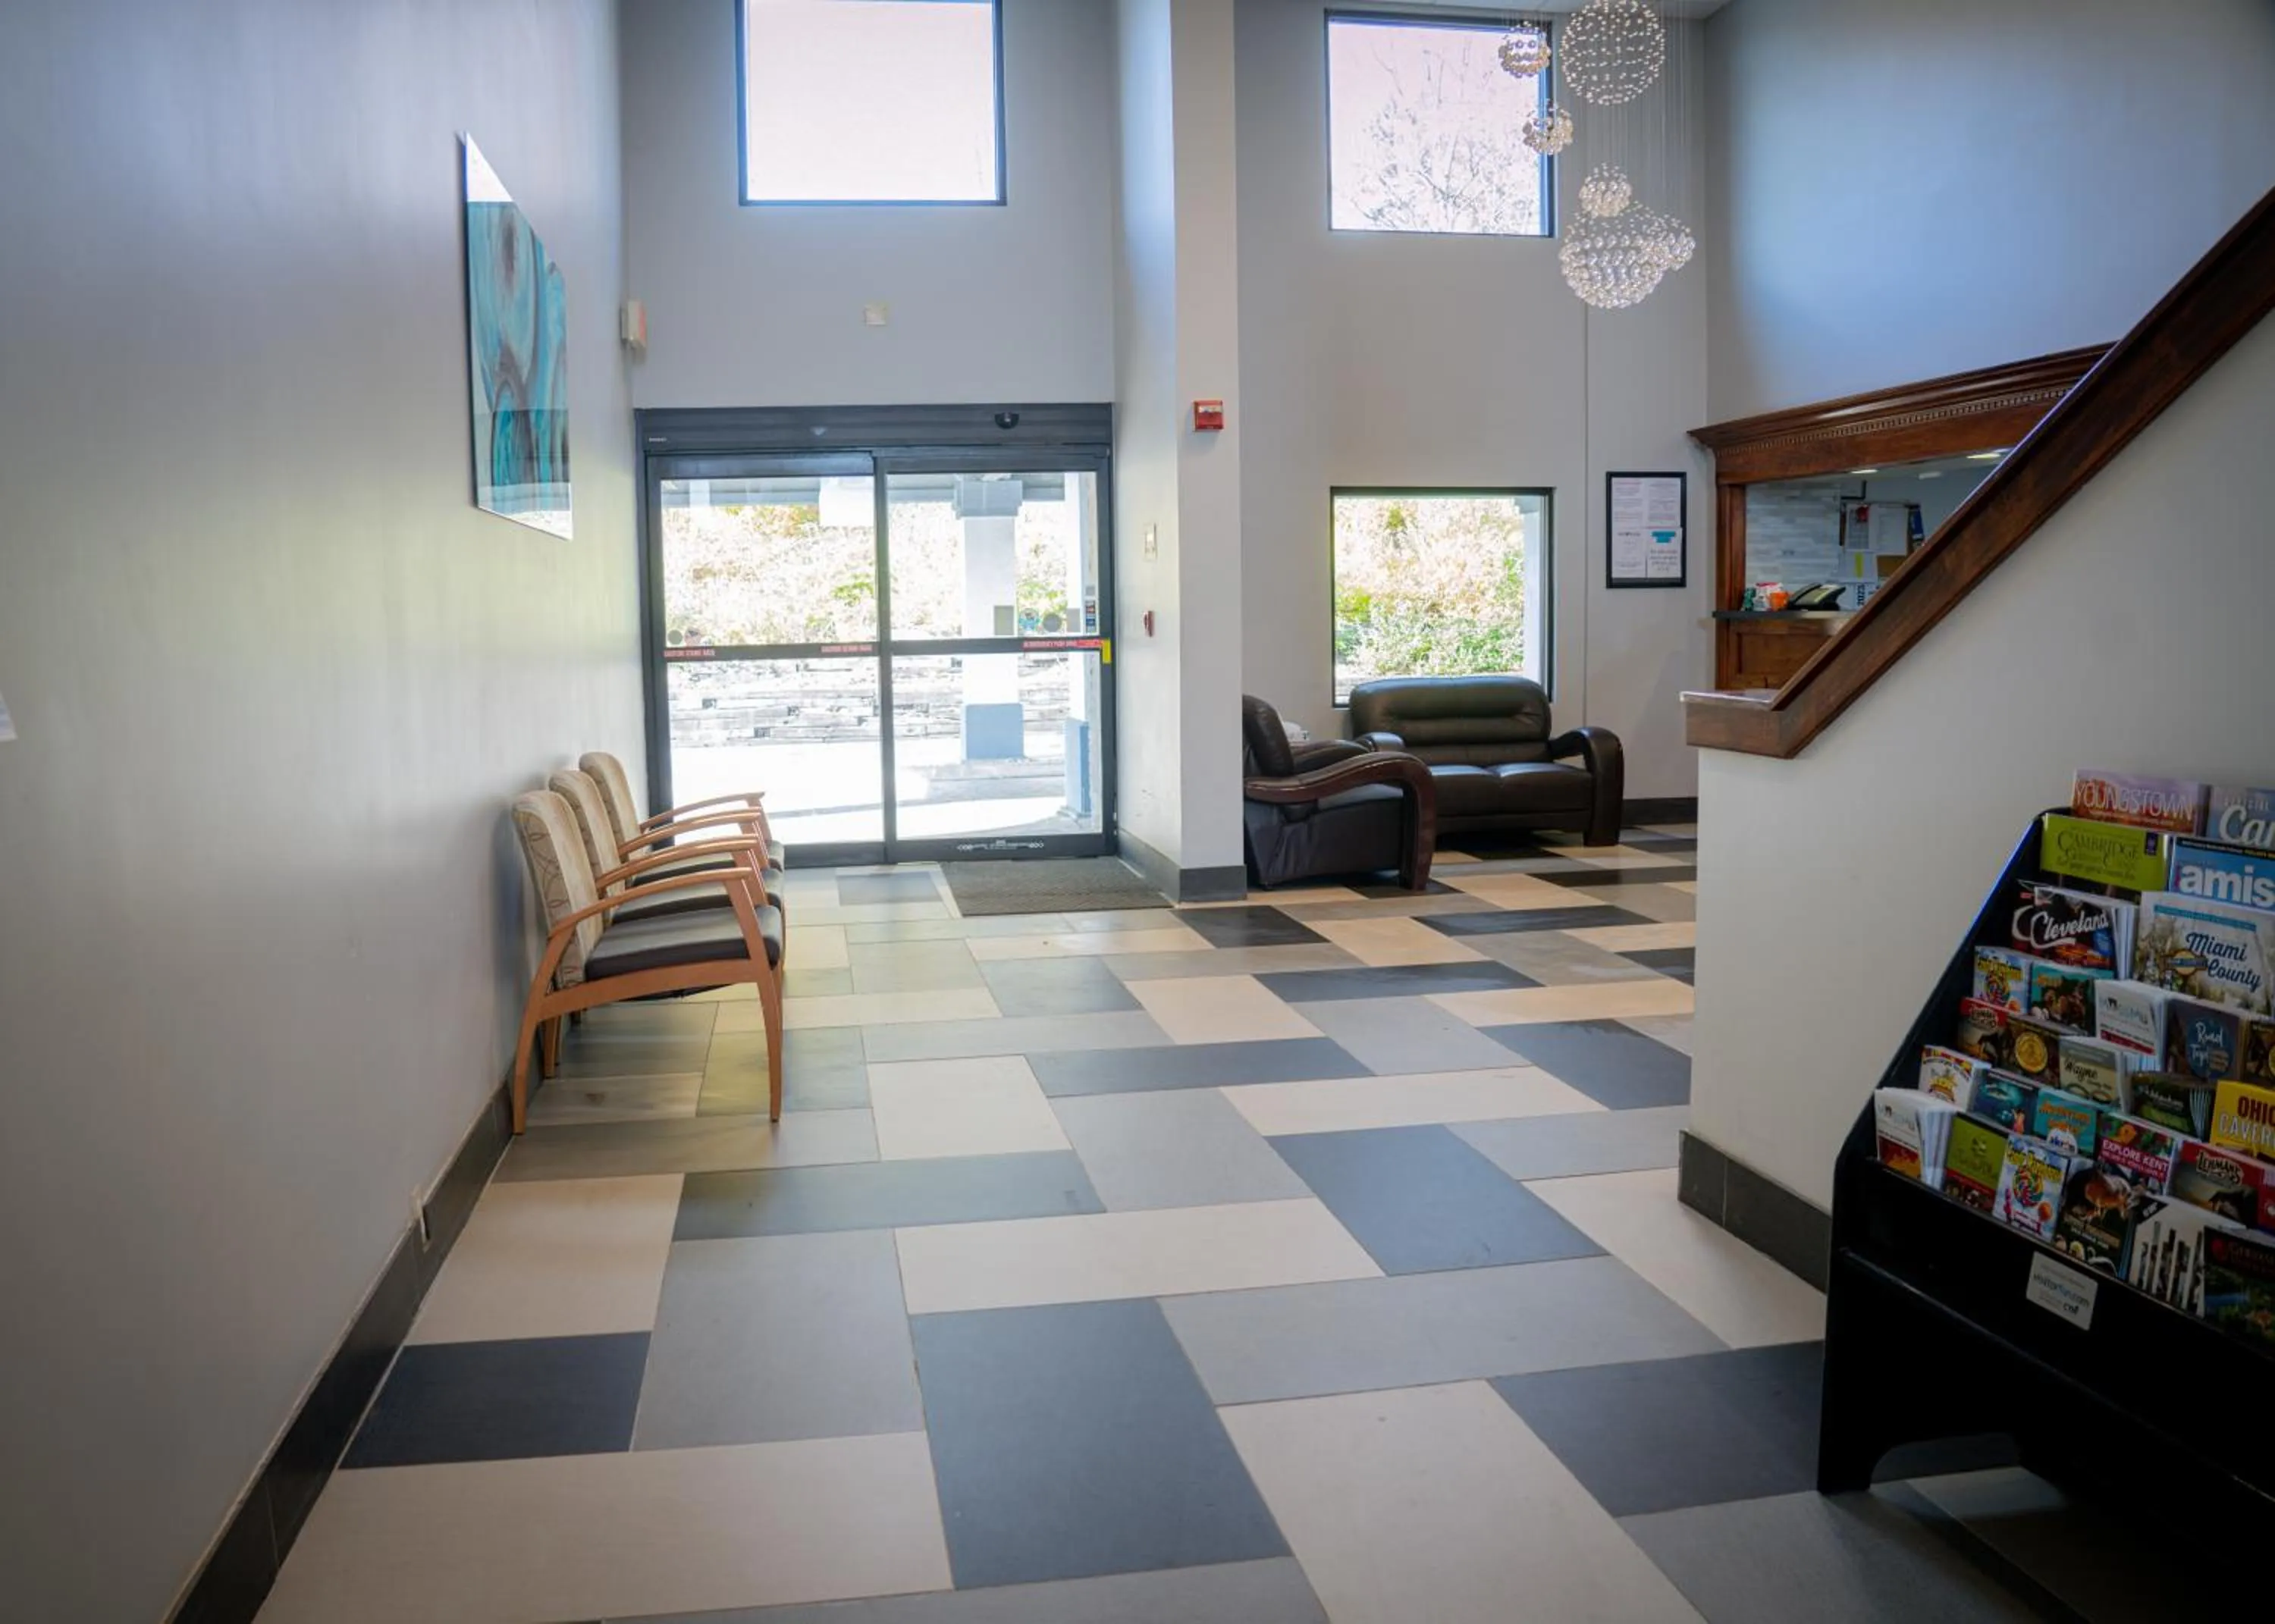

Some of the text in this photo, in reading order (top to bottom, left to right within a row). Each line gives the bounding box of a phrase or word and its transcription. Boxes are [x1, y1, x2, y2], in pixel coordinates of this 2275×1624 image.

[2074, 779, 2195, 821] YOUNGSTOWN
[2030, 909, 2110, 949] Cleveland
[2186, 932, 2248, 962] Miami
[2208, 958, 2261, 993] County
[2103, 1140, 2142, 1162] EXPLORE
[2142, 1154, 2168, 1172] KENT
